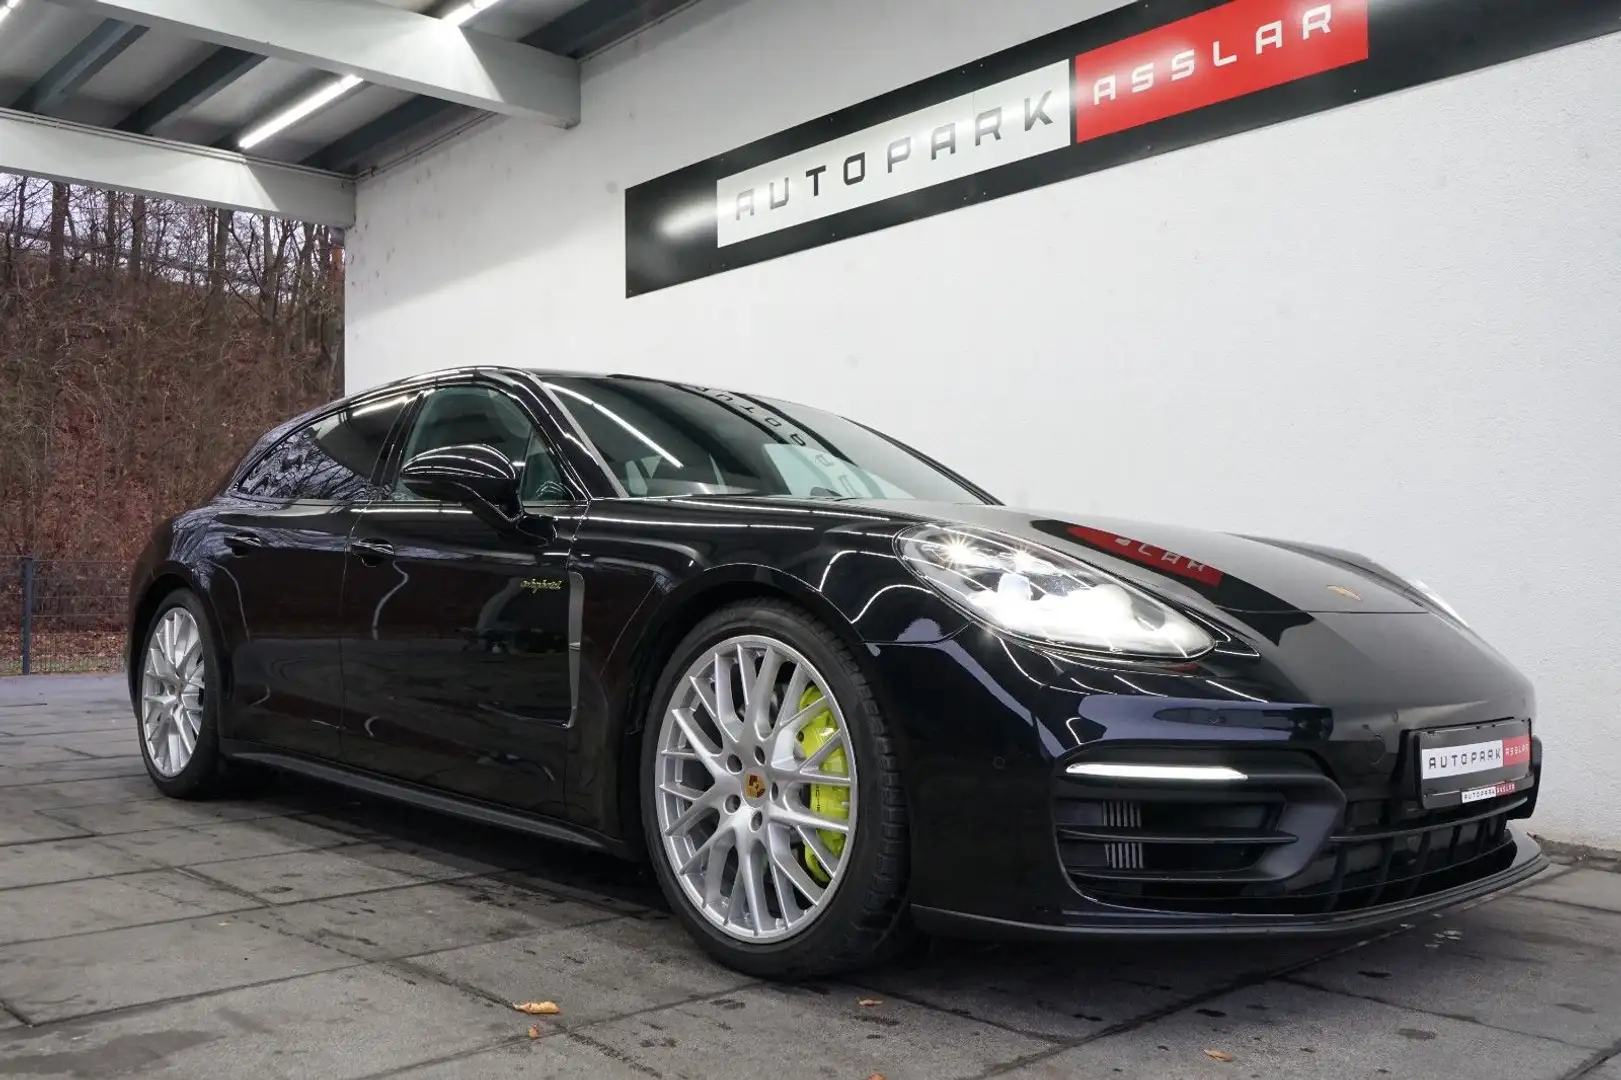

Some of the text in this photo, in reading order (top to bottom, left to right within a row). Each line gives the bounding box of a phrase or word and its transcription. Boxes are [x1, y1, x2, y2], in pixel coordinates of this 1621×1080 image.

[735, 3, 1331, 221] AUTOPARK ASSLAR
[1428, 748, 1501, 770] AUTOPARK
